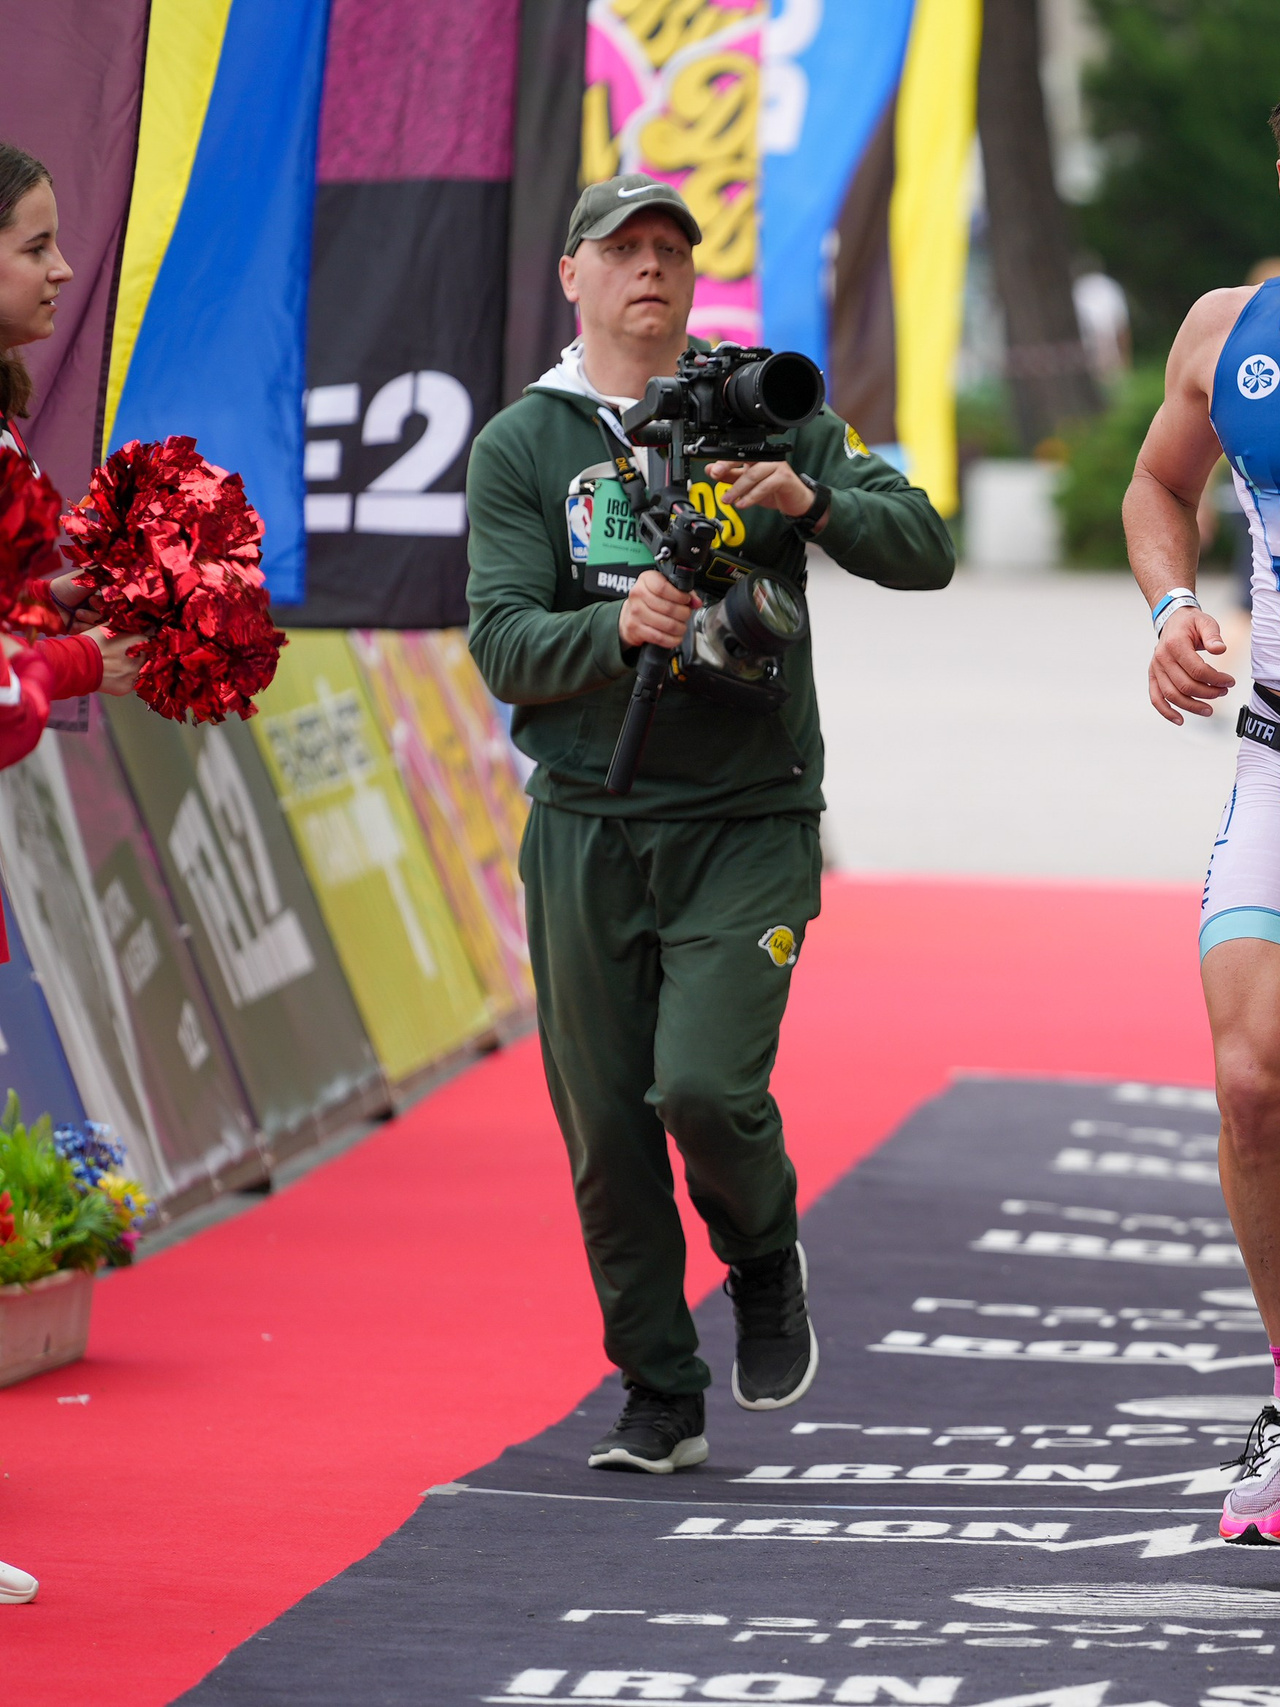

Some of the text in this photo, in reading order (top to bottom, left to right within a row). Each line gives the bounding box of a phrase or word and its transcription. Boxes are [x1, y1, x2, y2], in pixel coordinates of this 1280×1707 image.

[607, 498, 636, 518] IRO
[604, 516, 643, 543] STA
[597, 571, 637, 593] ВИДЕ
[744, 1463, 1122, 1480] IRON
[672, 1517, 1072, 1540] IRON
[505, 1668, 965, 1704] IRON
